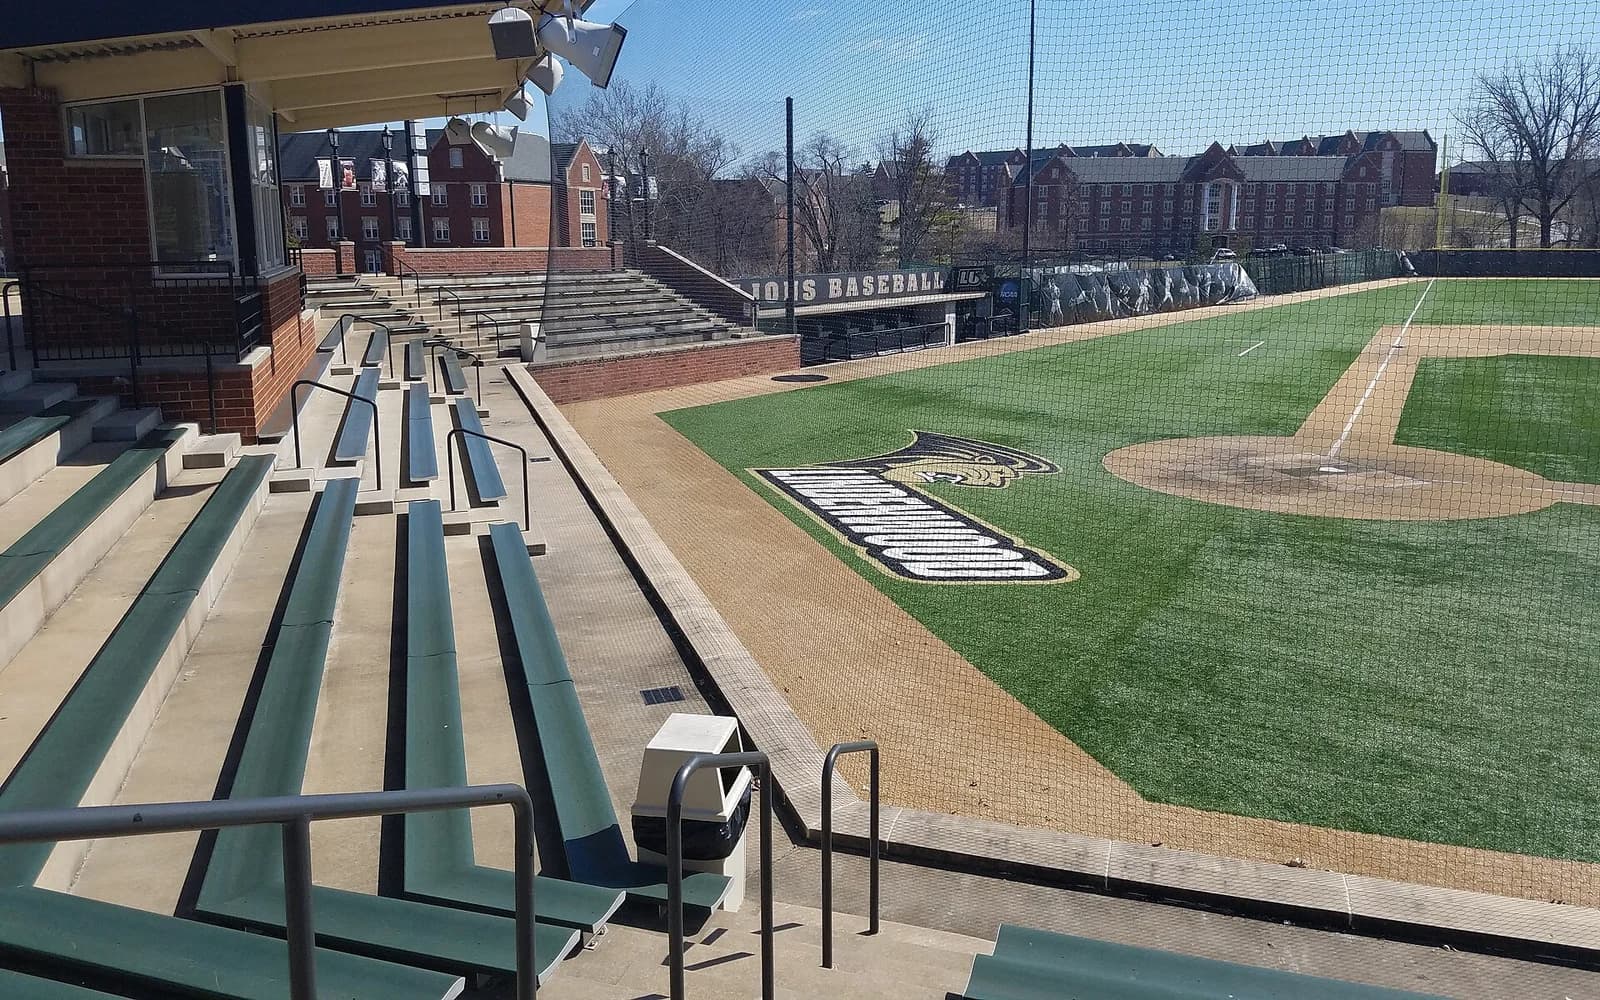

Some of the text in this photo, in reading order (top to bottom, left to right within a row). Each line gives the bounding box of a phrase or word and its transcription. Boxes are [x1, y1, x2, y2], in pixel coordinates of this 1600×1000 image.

[733, 272, 944, 302] IONS BASEBALL
[767, 469, 1053, 577] LINDENWOOD
